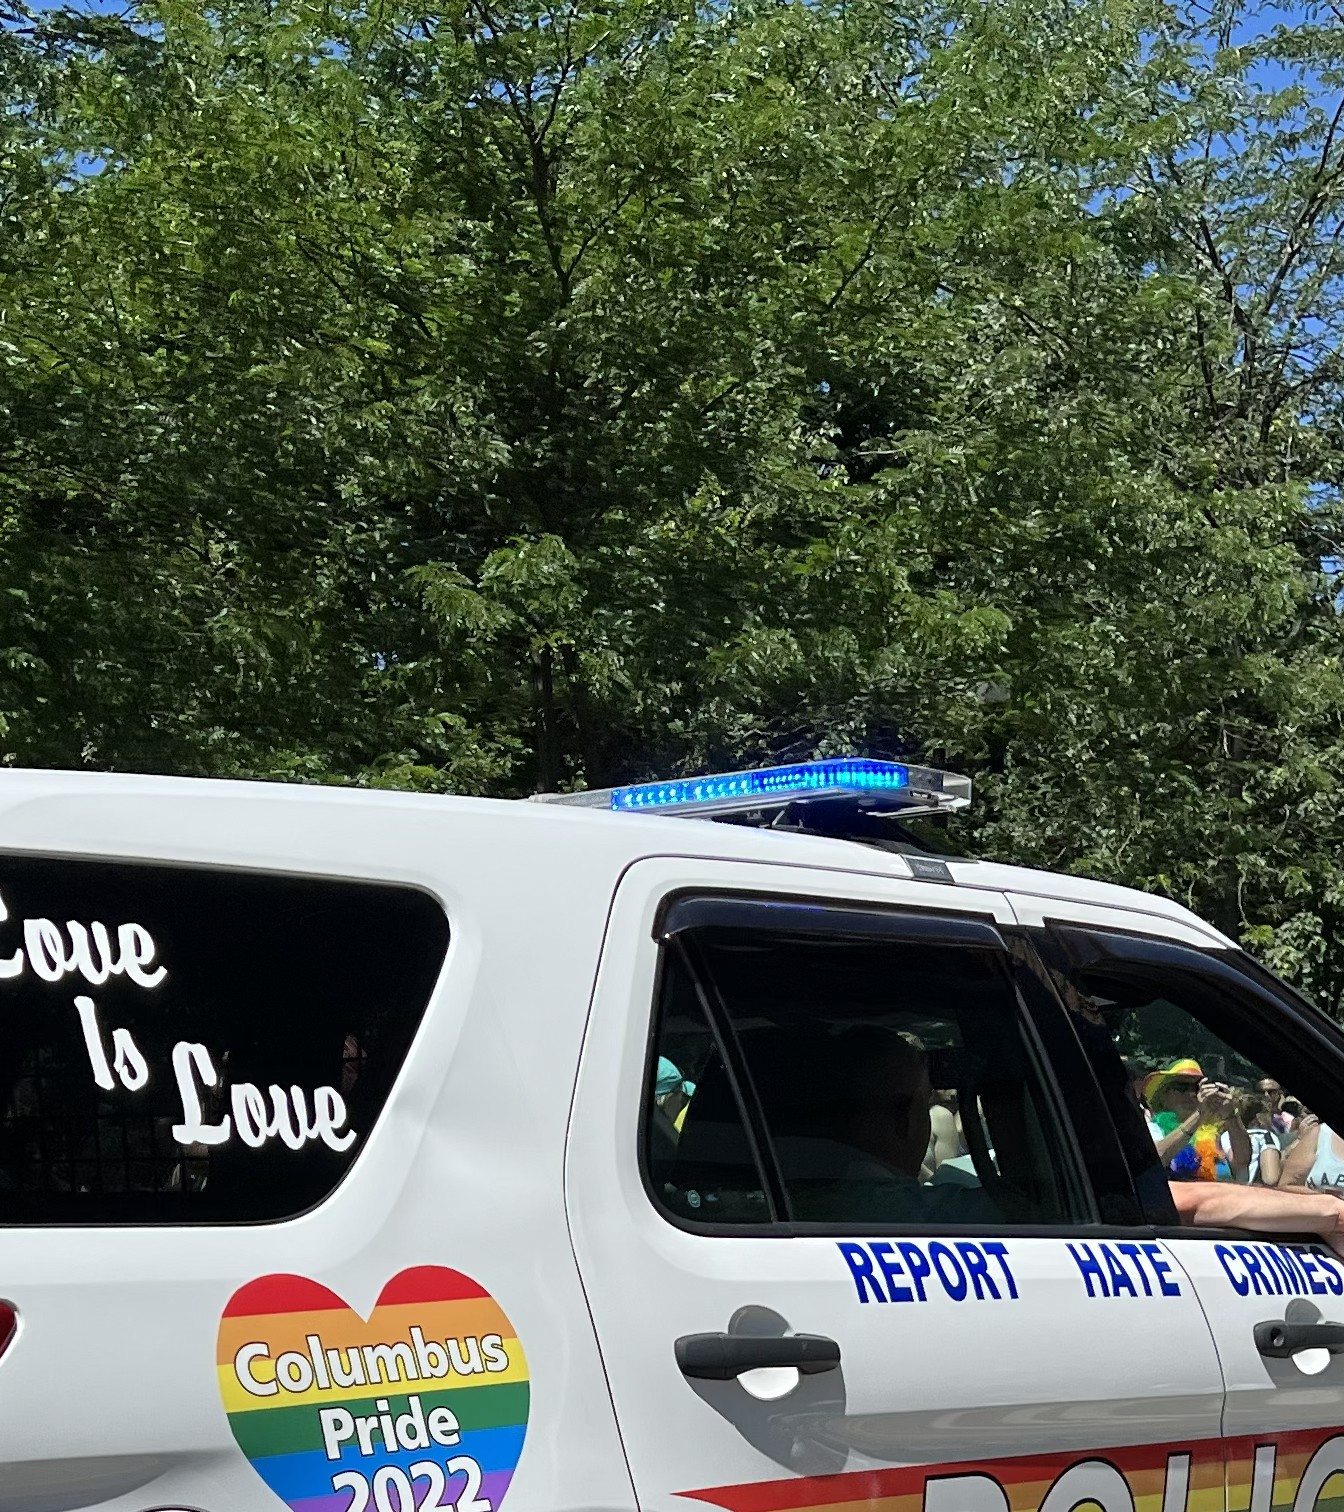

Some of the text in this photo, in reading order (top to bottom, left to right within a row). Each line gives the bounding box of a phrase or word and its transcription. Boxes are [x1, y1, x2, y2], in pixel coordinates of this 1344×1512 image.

[74, 996, 149, 1091] Is
[172, 1041, 356, 1152] Love
[836, 1241, 1344, 1303] REPORT HATE CRIMES
[234, 1326, 509, 1397] Columbus
[318, 1395, 462, 1461] Pride
